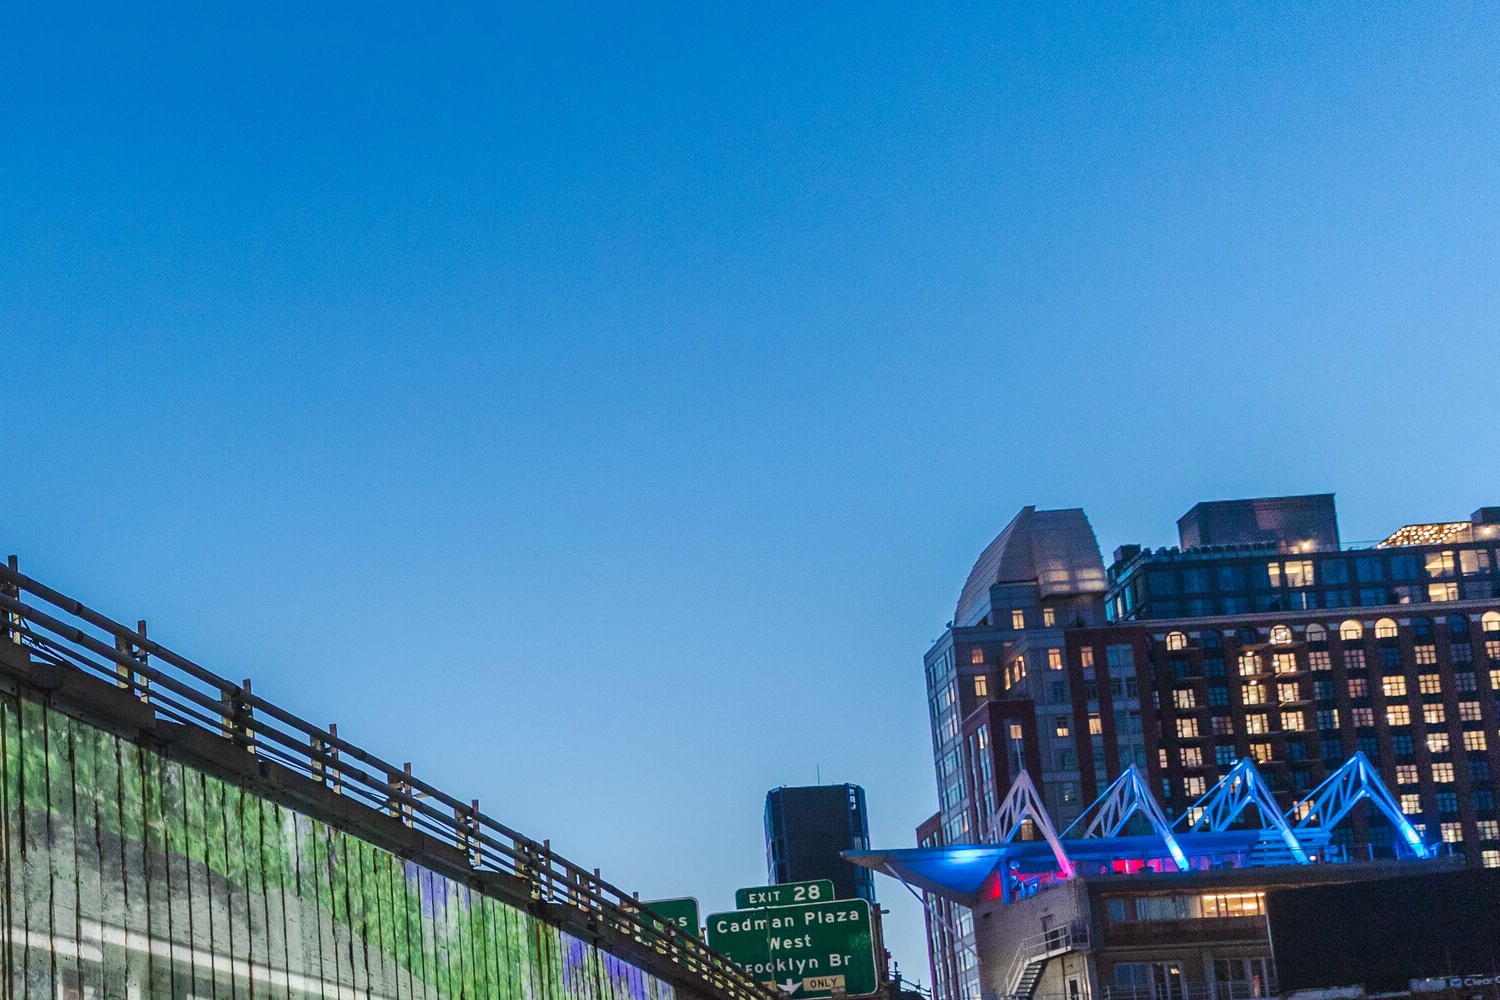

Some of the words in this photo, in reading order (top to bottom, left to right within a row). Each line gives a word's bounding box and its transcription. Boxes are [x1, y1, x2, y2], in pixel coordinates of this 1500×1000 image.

[749, 891, 781, 904] EXIT
[794, 885, 820, 901] 28
[717, 917, 795, 933] Cadman
[804, 910, 860, 926] Plaza
[766, 934, 812, 950] West
[829, 953, 852, 967] Br
[810, 978, 838, 989] ONLY
